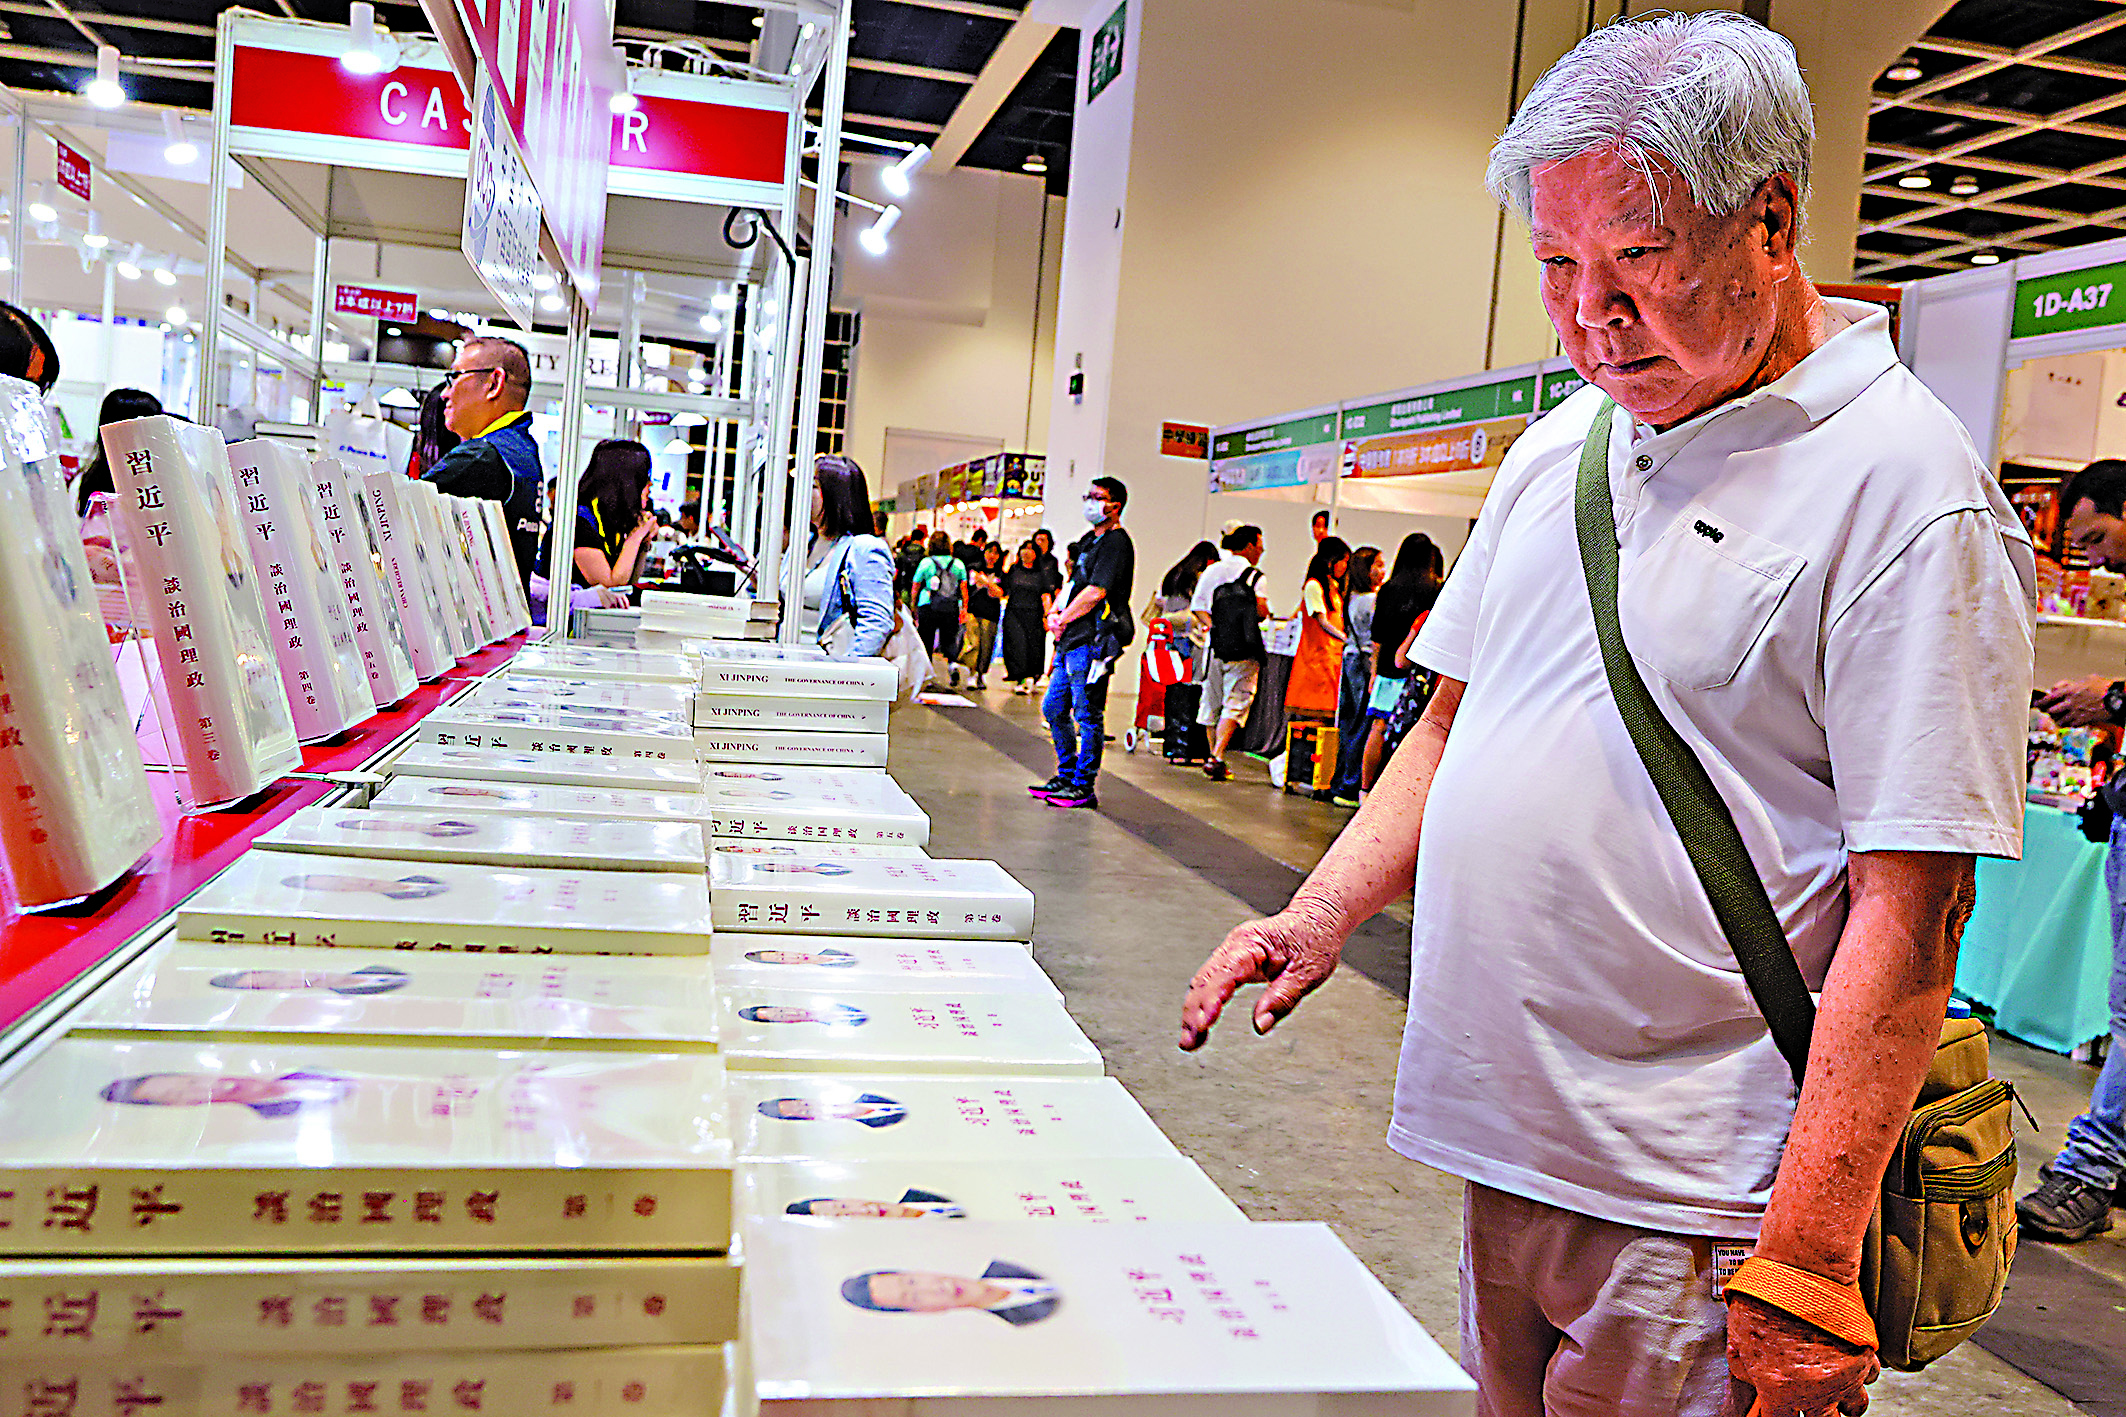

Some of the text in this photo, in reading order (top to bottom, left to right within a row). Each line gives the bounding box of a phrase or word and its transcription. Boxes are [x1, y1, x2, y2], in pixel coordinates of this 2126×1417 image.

[2033, 282, 2113, 318] 1D-A37
[124, 448, 172, 547] 習近平
[238, 465, 276, 541] 習近平
[316, 481, 346, 544] 習近平
[269, 563, 303, 649] 談治國理政
[162, 575, 206, 689] 談治國理政
[719, 673, 729, 682] XI
[731, 674, 769, 684] JINPING
[711, 707, 721, 716] XI
[722, 708, 760, 717] JINPING
[709, 742, 720, 750] XI
[721, 742, 759, 751] JINPING
[738, 903, 1001, 924] 習近平 談治國理政 第五卷
